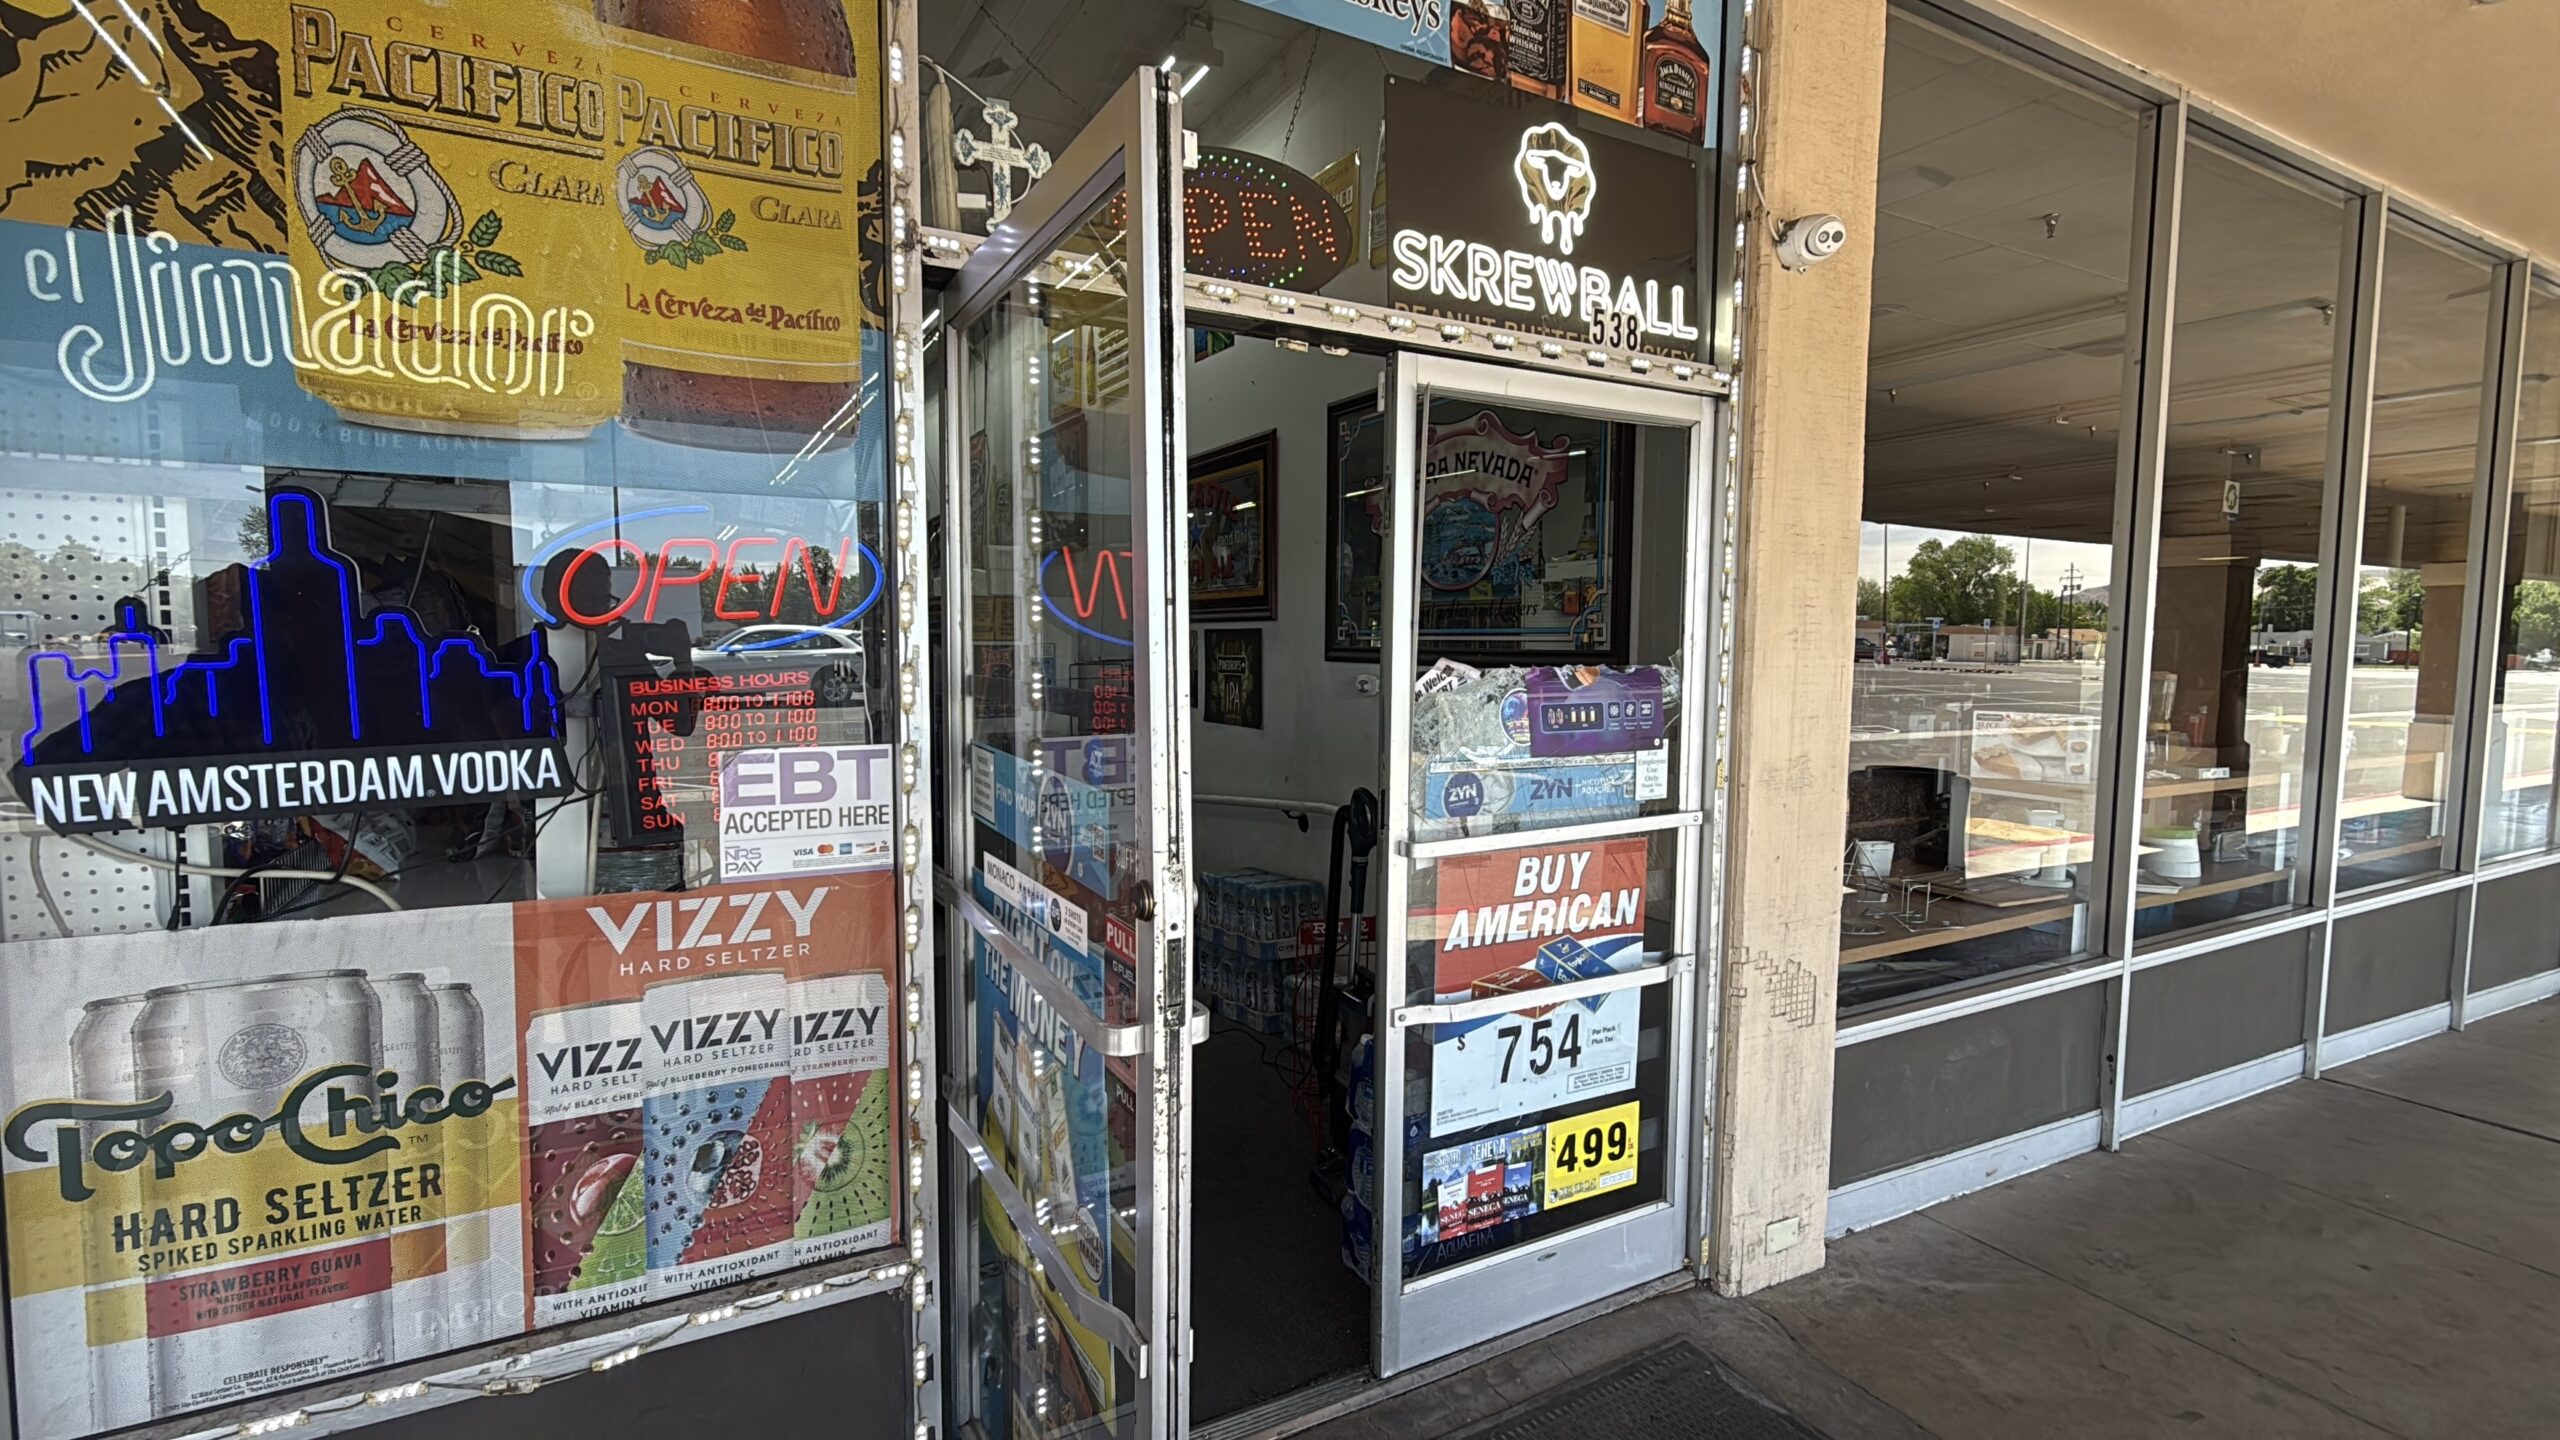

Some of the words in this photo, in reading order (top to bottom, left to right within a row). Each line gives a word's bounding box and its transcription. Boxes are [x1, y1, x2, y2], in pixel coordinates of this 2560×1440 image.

[386, 16, 604, 76] CERVEZA
[1509, 33, 1544, 54] WHISKEY
[290, 2, 606, 143] PACIFICO
[679, 85, 843, 127] CERVEZA
[611, 74, 844, 179] PACIFICO
[489, 157, 606, 209] CLARA
[750, 193, 843, 231] CLARA
[1391, 228, 1699, 342] SKREWBALL
[56, 204, 595, 403] Jimador
[625, 282, 651, 316] La
[654, 288, 745, 325] Cerveza
[745, 302, 766, 323] del
[1591, 307, 1640, 352] 538
[1453, 450, 1536, 489] NEVADA
[558, 536, 851, 626] OPEN
[629, 676, 734, 696] BUSINESS
[739, 671, 811, 688] HOURS
[1225, 680, 1241, 712] IPA
[630, 701, 679, 717] MON
[744, 694, 764, 708] TO
[633, 719, 677, 735] TUE
[704, 713, 741, 731] 8:00
[745, 713, 766, 726] TO
[773, 708, 817, 725] 11:00
[634, 737, 686, 754] WED
[706, 732, 743, 749] 8:00
[747, 730, 768, 744] TO
[775, 725, 818, 742] 11:00
[636, 756, 681, 774] THU
[723, 748, 889, 808] EBT
[29, 768, 138, 826] NEW
[146, 753, 428, 818] AMSTERDAM
[431, 745, 563, 797] VODKA
[638, 777, 673, 793] FRI
[1447, 783, 1478, 802] ZYN
[1529, 777, 1574, 801] ZYN
[640, 795, 677, 811] SAT
[642, 812, 687, 831] SUN
[724, 808, 833, 836] ACCEPTED
[839, 804, 890, 828] HERE
[1043, 803, 1067, 838] ZYN
[725, 847, 763, 861] NRS
[725, 860, 763, 875] PAY
[793, 848, 814, 857] VISA
[986, 860, 1016, 891] MONACO
[1513, 850, 1592, 897] BUY
[586, 885, 831, 956] VIZZY
[1442, 887, 1641, 953] AMERICAN
[1105, 922, 1137, 960] PULL
[619, 955, 692, 977] HARD
[704, 942, 811, 967] SELTZER
[789, 1005, 881, 1046] IZZY
[984, 940, 1012, 996] THE
[1009, 966, 1086, 1081] MONEY
[649, 1008, 782, 1054] VIZZY
[818, 1038, 875, 1054] SELTZER
[1591, 1028, 1602, 1036] Per
[1602, 1025, 1616, 1035] Pack
[1591, 1037, 1603, 1046] Plus
[1604, 1035, 1614, 1044] Tax
[662, 1054, 704, 1068] HARD
[711, 1042, 775, 1060] SELTZER
[1456, 1033, 1466, 1052] $
[1497, 1013, 1582, 1084] 754
[670, 1068, 728, 1085] BLUEBERRY
[801, 1057, 859, 1073] STRAWBERRY
[550, 1080, 593, 1095] HARD
[574, 1096, 610, 1110] BLACK
[1115, 1083, 1136, 1113] PULL
[2, 1088, 272, 1203] Topo
[280, 1063, 518, 1166] Chico
[1470, 1136, 1506, 1161] SENECA
[1556, 1121, 1627, 1173] 499
[113, 1196, 243, 1255] HARD
[265, 1162, 444, 1225] SELTZER
[1467, 1200, 1502, 1218] SENECA
[137, 1241, 219, 1273] SPIKED
[227, 1218, 347, 1256] SPARKLING
[355, 1204, 423, 1232] WATER
[805, 1227, 879, 1256] ANTIOXIDANT
[1437, 1226, 1496, 1261] AQUAFINA
[663, 1269, 696, 1284] WITH
[698, 1249, 780, 1278] ANTIOXIDANT
[1078, 1239, 1101, 1274] MADE
[178, 1263, 303, 1301] STRAWBERRY
[310, 1252, 363, 1276] GUAVA
[689, 1272, 744, 1292] VITAMIN
[747, 1268, 756, 1280] C
[216, 1285, 276, 1306] NATURALLY
[552, 1295, 583, 1311] WITH
[579, 1298, 636, 1319] VITAMIN
[222, 1369, 270, 1386] CELEBRATE
